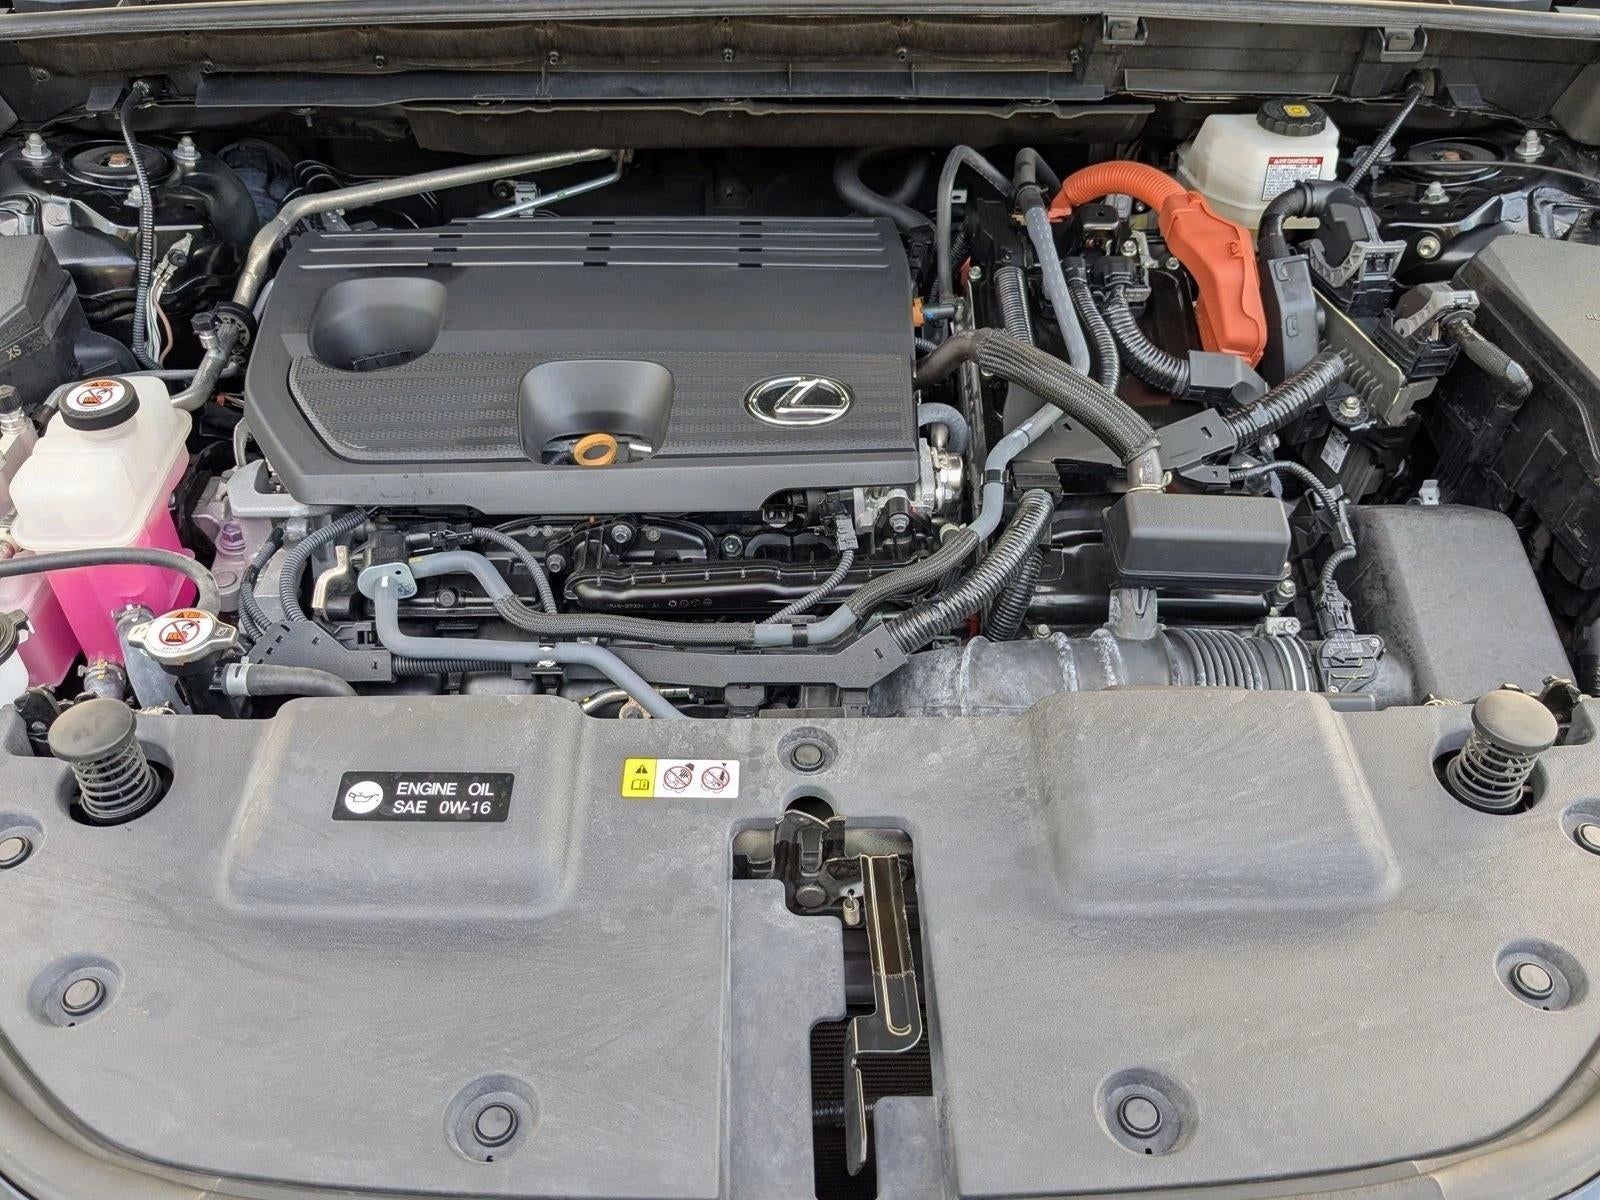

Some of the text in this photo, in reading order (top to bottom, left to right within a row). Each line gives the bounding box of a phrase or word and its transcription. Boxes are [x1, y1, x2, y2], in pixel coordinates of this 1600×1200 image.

[396, 782, 495, 796] ENGINE OIL
[393, 800, 491, 814] SAE 0W-16
